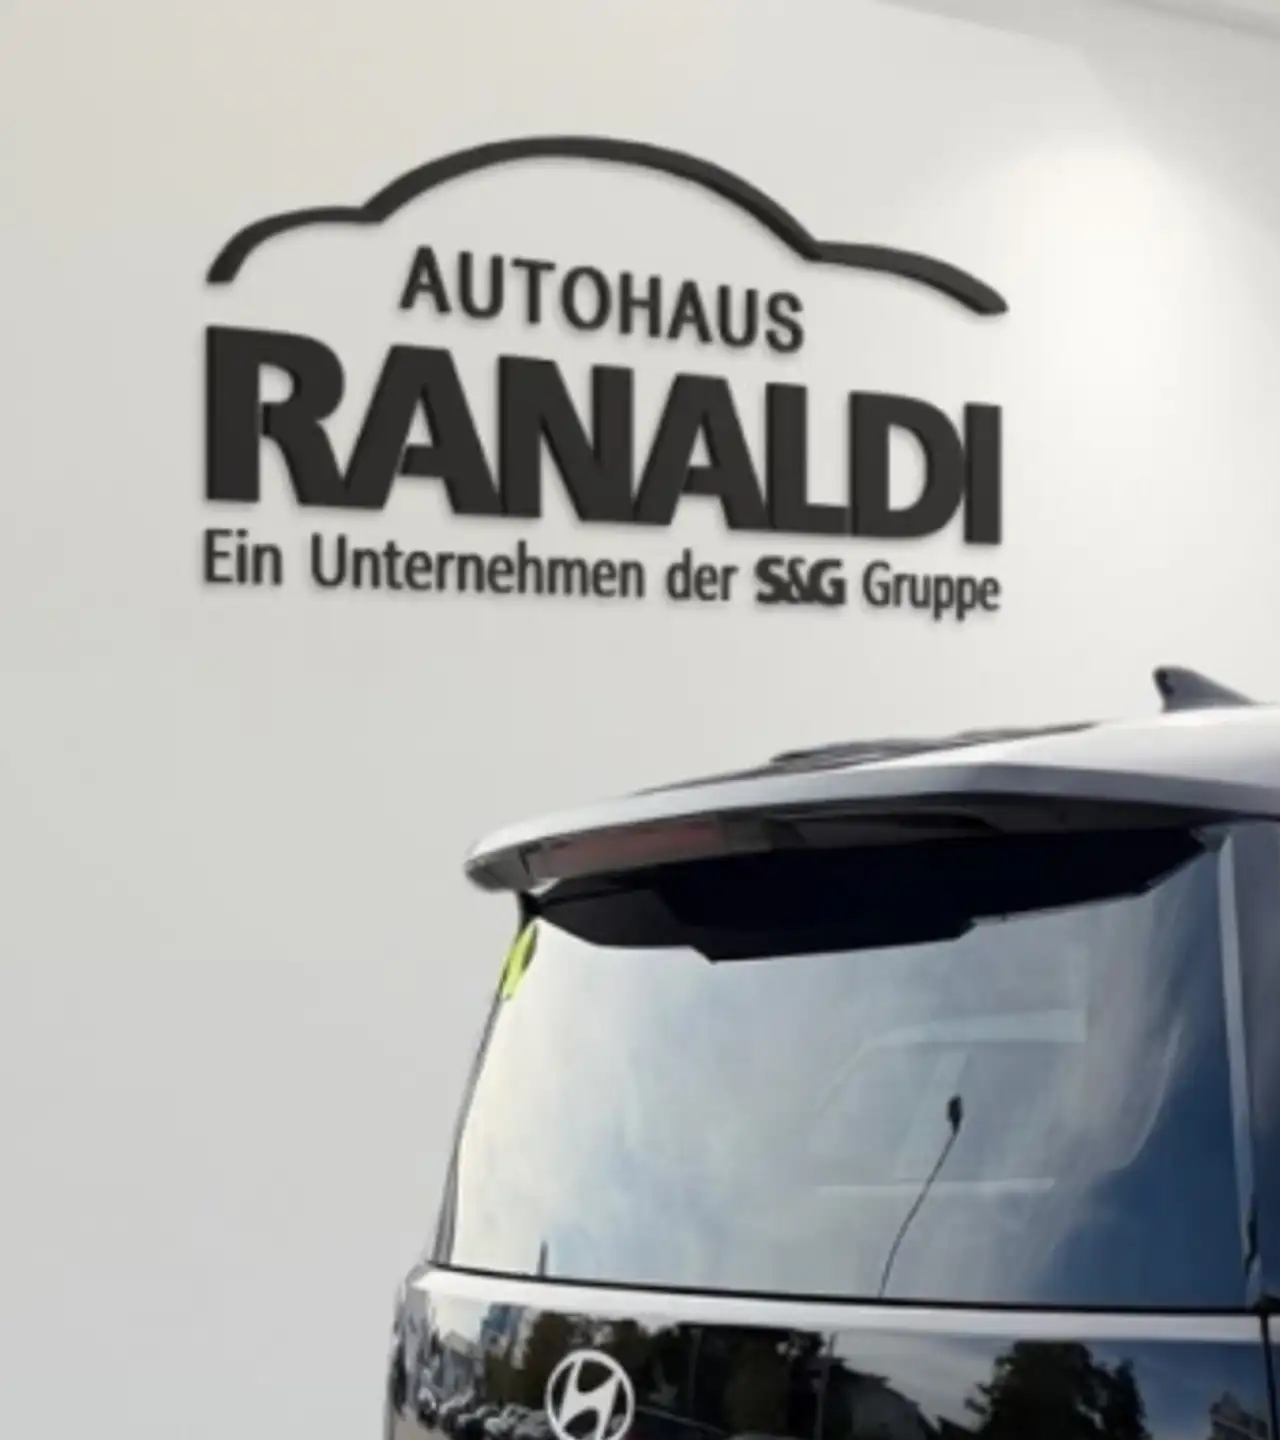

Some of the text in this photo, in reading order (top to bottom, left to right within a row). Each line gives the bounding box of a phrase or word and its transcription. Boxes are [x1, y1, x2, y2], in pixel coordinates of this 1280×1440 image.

[399, 245, 804, 355] AUTOHAUS
[205, 324, 1002, 546] RANALDI
[203, 527, 1001, 622] Ein Unternehmen der S&G Gruppe
